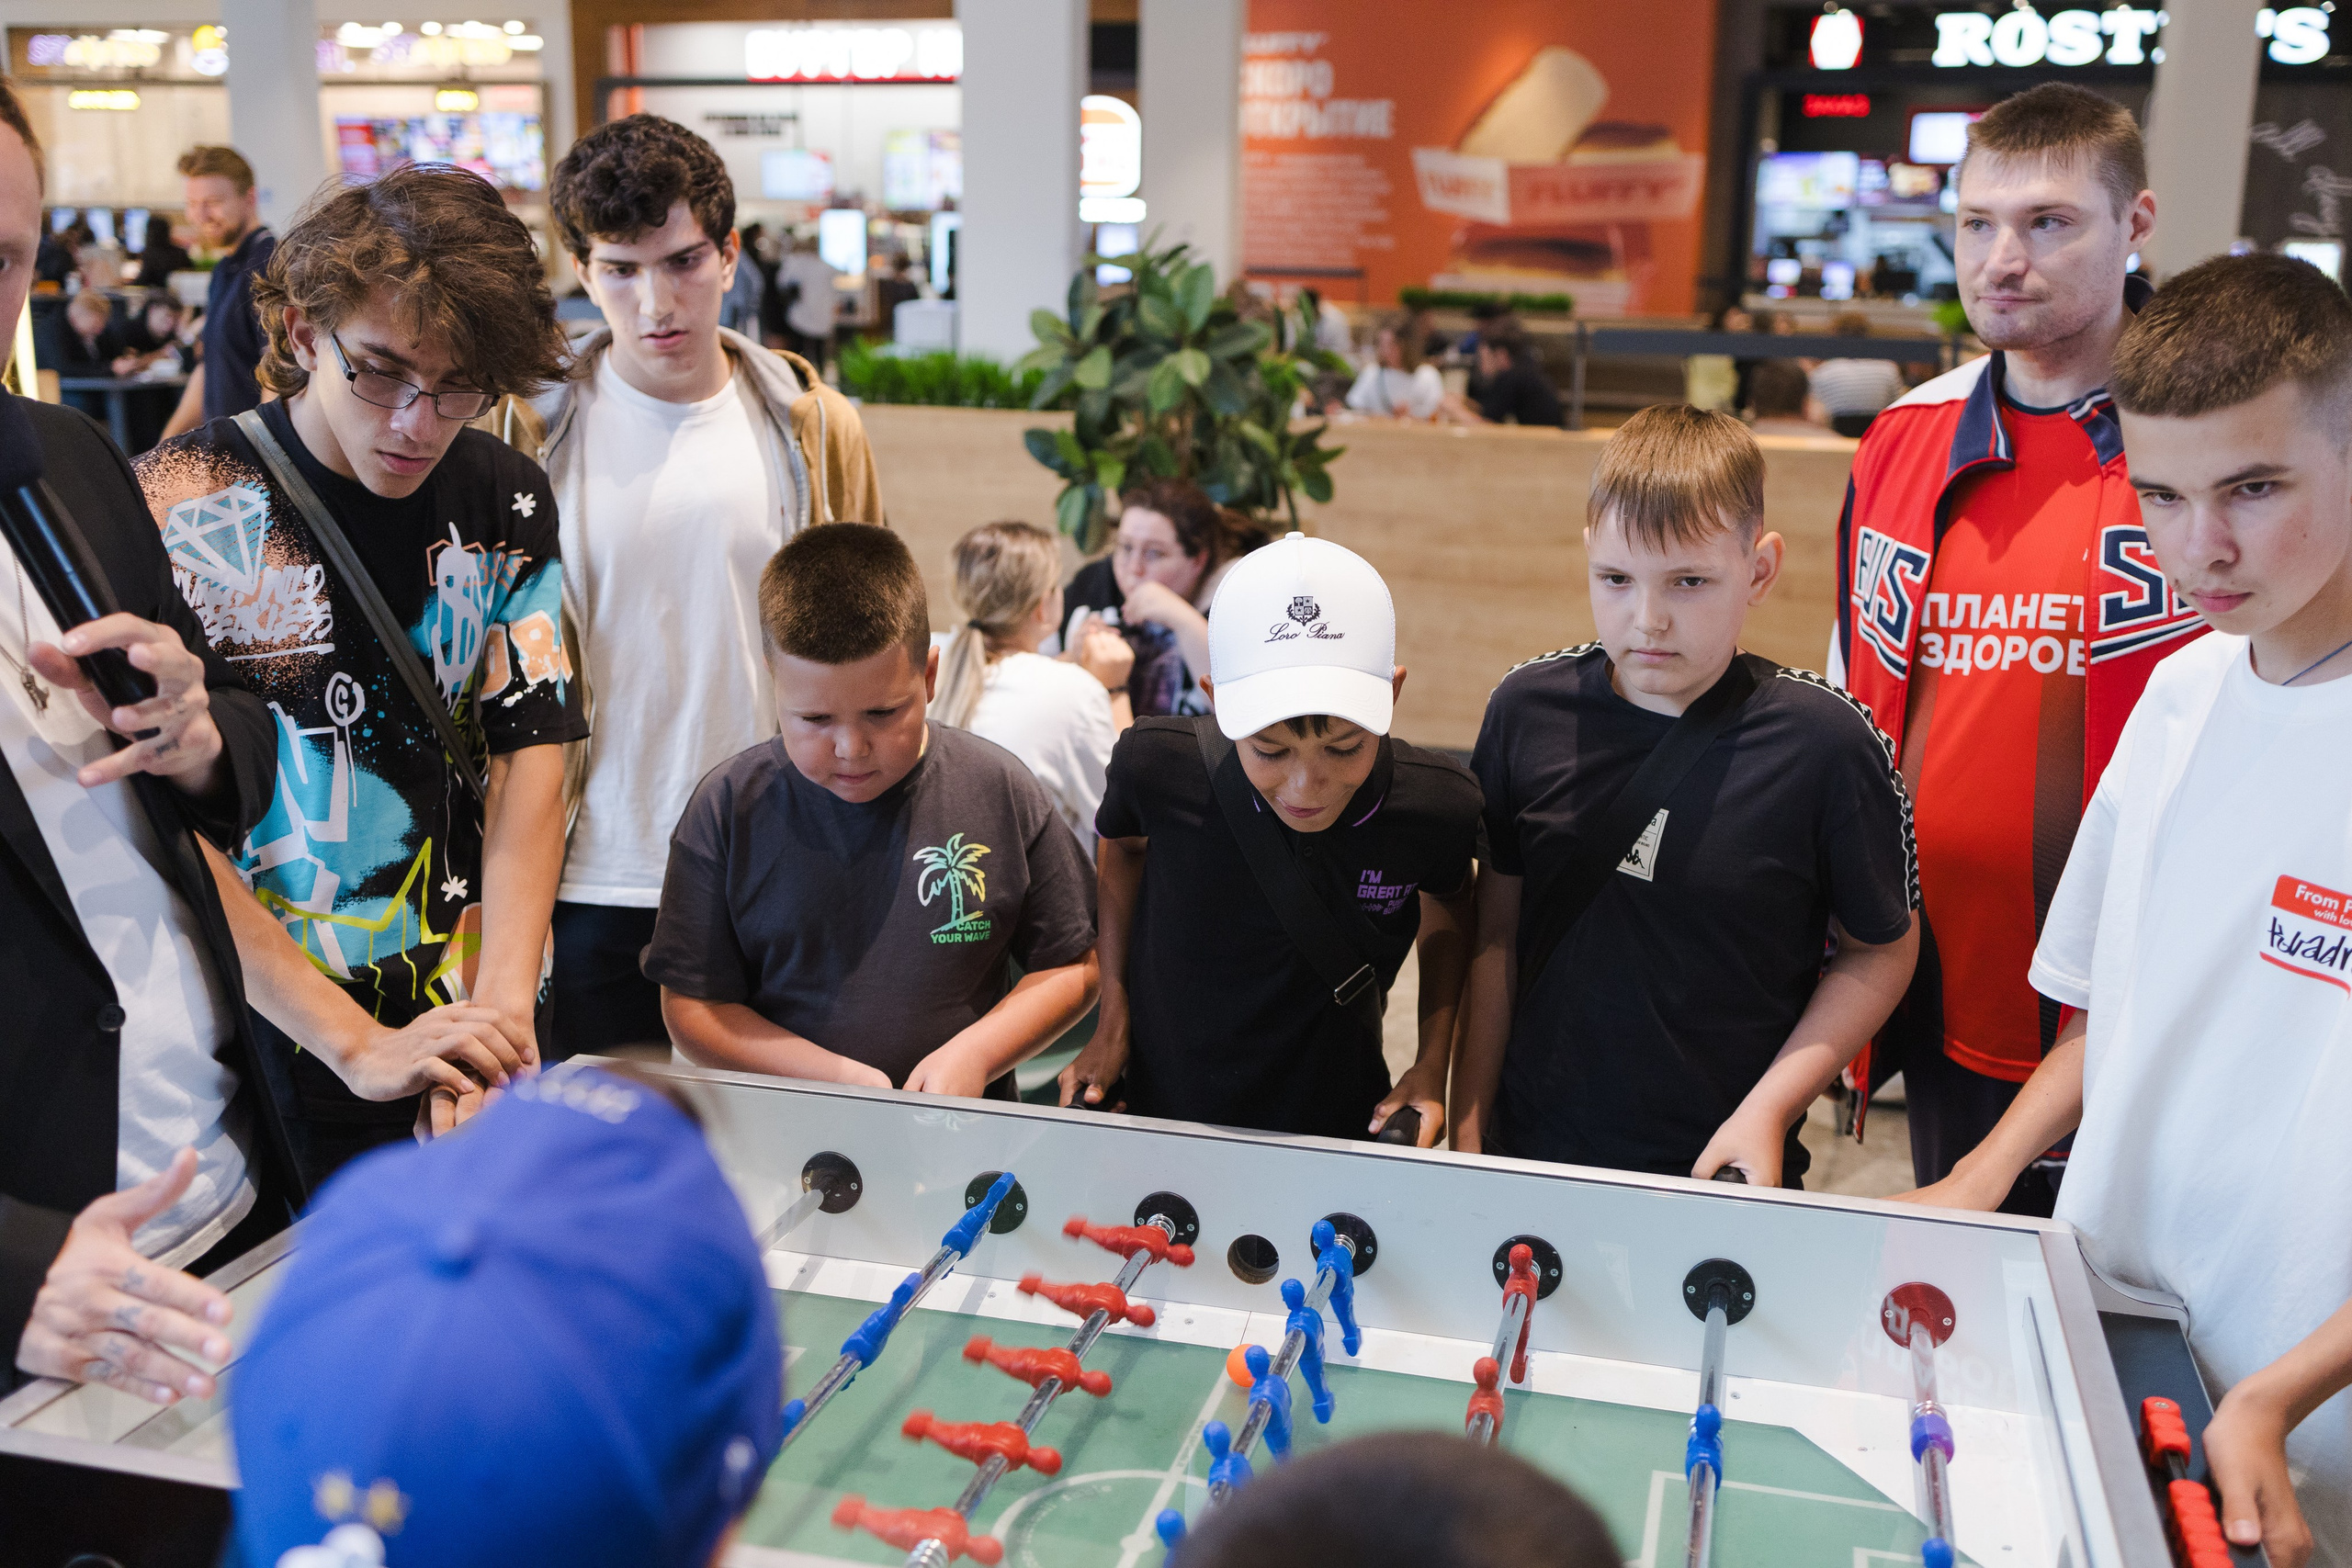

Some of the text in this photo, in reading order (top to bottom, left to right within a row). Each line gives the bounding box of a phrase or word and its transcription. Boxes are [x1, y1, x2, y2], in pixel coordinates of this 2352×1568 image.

[1932, 8, 2331, 68] ROST'S
[1264, 621, 1346, 642] Loro Piana
[1360, 869, 1383, 884] I'M
[1356, 884, 1404, 899] GREAT
[2295, 884, 2340, 910] From
[2313, 909, 2338, 922] with
[956, 919, 991, 931] CATCH
[930, 931, 990, 944] YOUR WAVE
